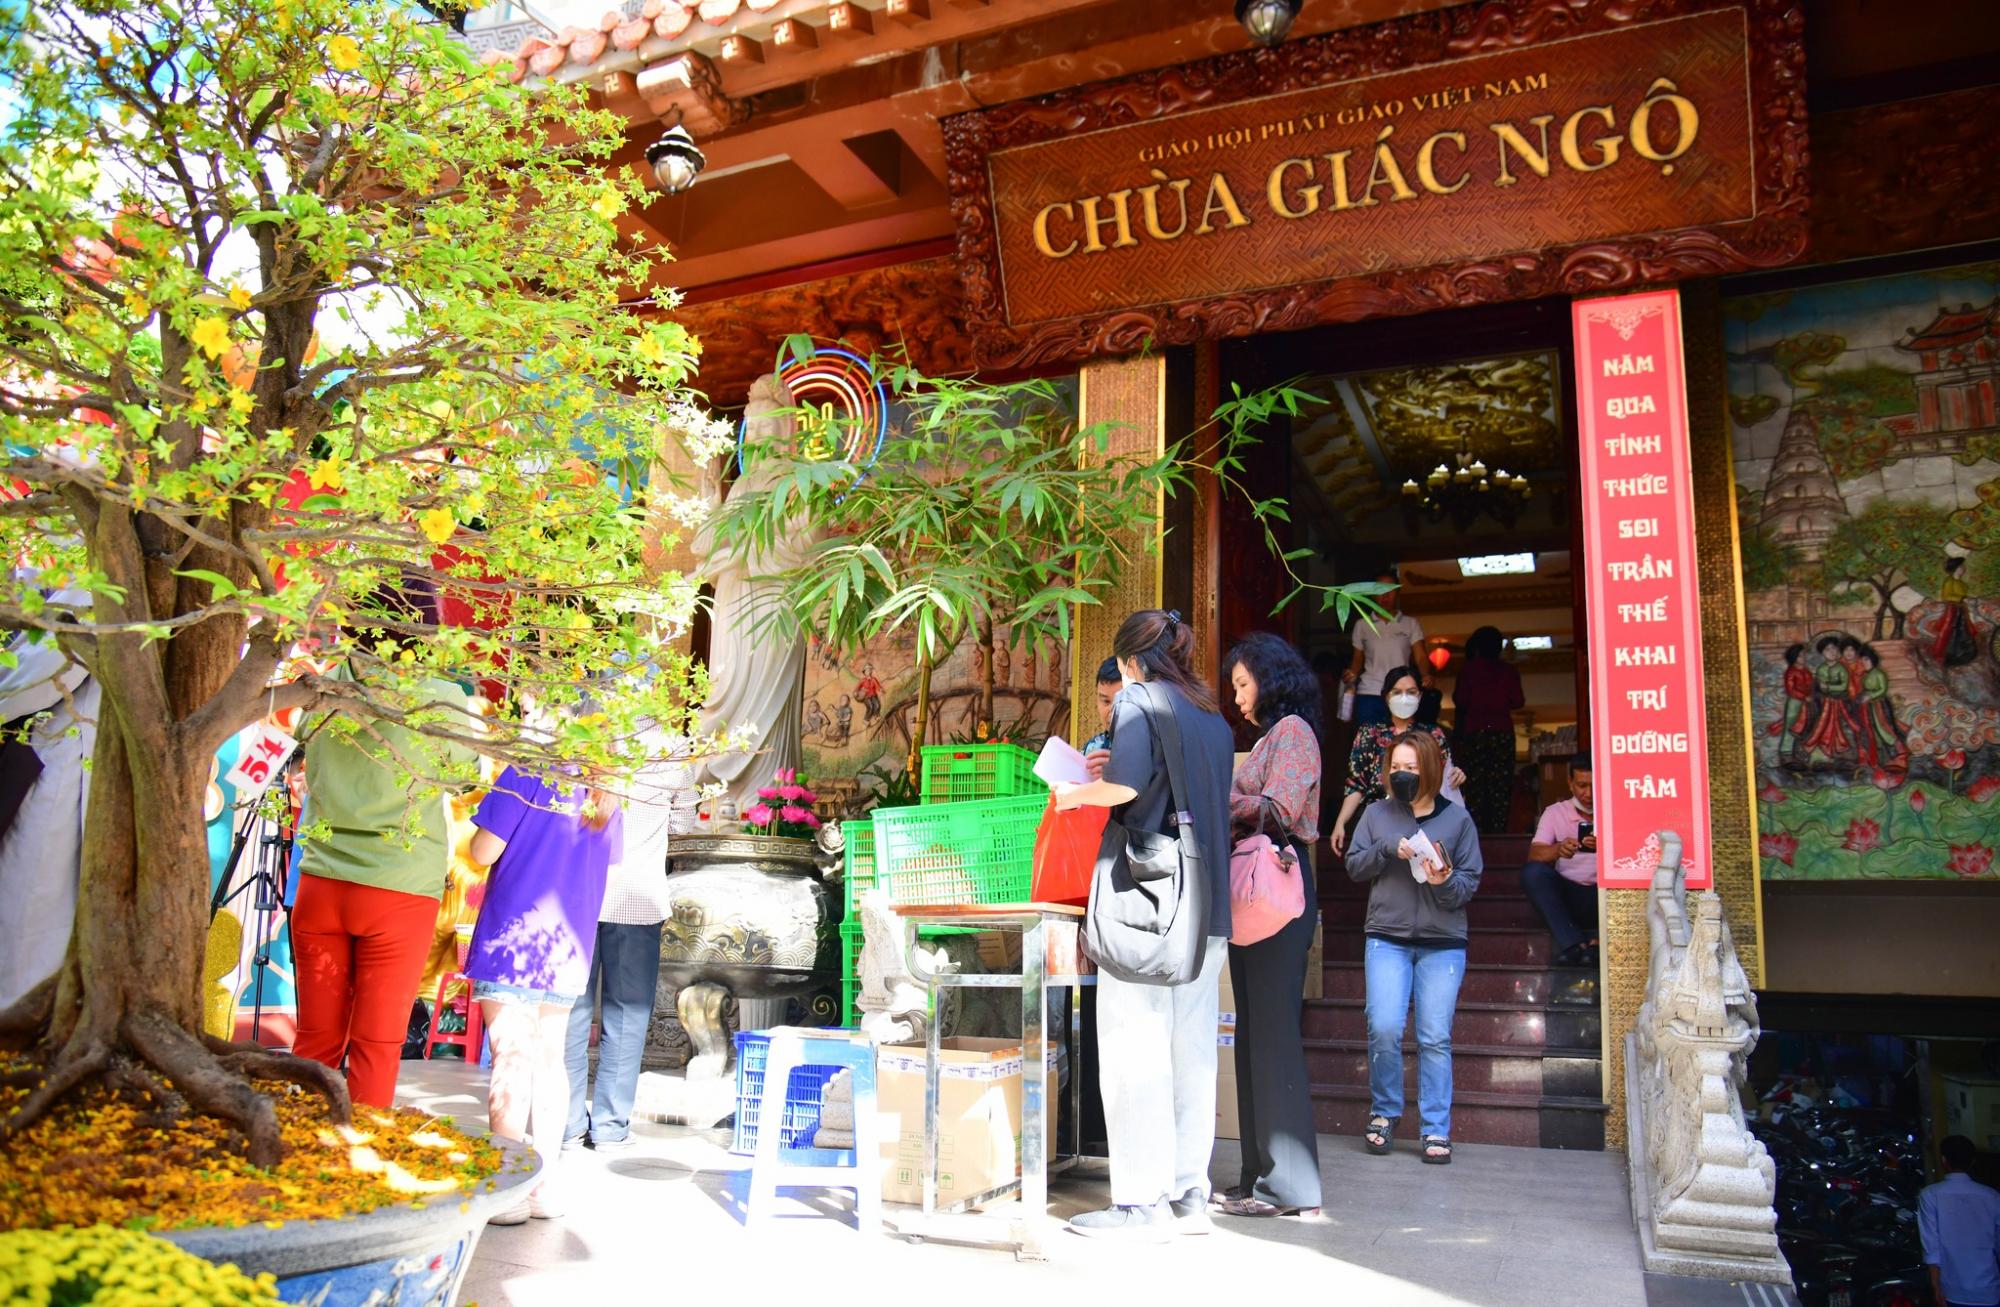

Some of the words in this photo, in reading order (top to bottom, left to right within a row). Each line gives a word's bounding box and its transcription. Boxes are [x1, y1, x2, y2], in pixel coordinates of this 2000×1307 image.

[1138, 138, 1199, 162] GIÁO
[1337, 100, 1404, 125] GIÁO
[1412, 86, 1476, 110] VIỆT
[1484, 73, 1549, 99] NAM
[1033, 169, 1251, 258] CHÙA
[1266, 125, 1471, 219] GIÁC
[1489, 77, 1699, 188] NGỘ
[1603, 354, 1655, 377] NĂM
[1606, 395, 1656, 419] QUA
[1602, 473, 1668, 498] THỨC
[1618, 518, 1658, 538] SOI
[1617, 595, 1669, 624] THẾ
[1615, 645, 1676, 667] KHAI
[1627, 685, 1668, 710] TRÍ
[239, 736, 286, 784] 54
[1624, 774, 1677, 799] TÂM
